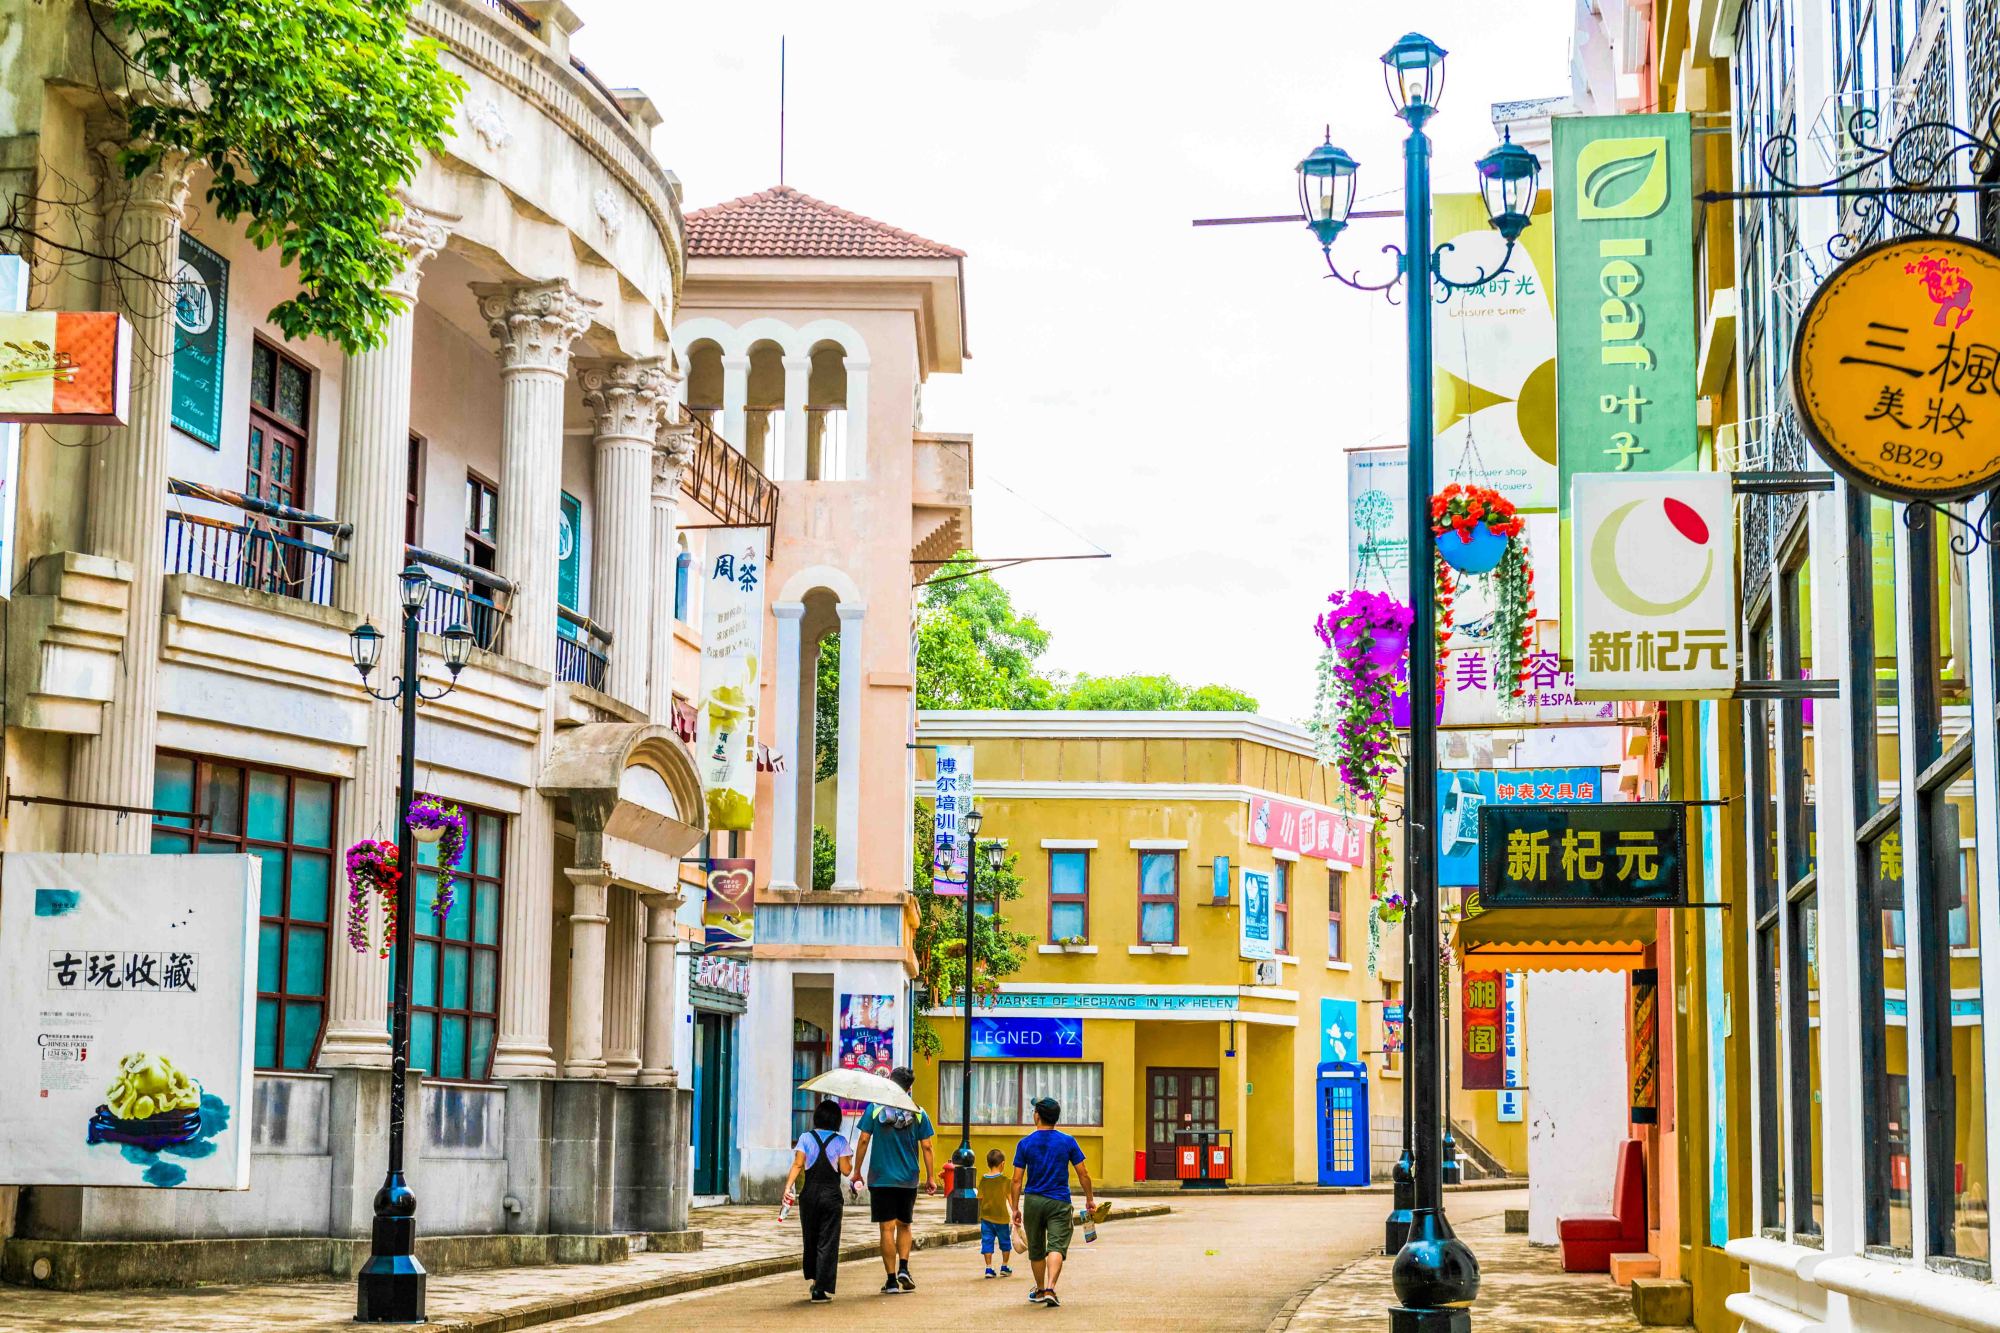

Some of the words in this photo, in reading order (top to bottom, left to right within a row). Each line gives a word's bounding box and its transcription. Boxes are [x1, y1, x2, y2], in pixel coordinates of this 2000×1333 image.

[1449, 307, 1494, 317] Leisure
[1497, 306, 1527, 315] time
[1600, 239, 1651, 370] leaf
[1840, 322, 2000, 396] 三楓
[1600, 384, 1651, 470] 叶子
[1506, 467, 1527, 479] shop
[1879, 441, 1943, 471] 8B29
[1494, 483, 1532, 491] flowers
[1456, 649, 1575, 692] 美容
[1588, 629, 1729, 673] 新杞元
[935, 757, 957, 864] 博尔培训中
[1498, 783, 1594, 800] 钟表文具店
[1507, 828, 1660, 882] 新杞元
[53, 952, 197, 992] 古玩收藏
[996, 996, 1046, 1006] MARKET
[1053, 997, 1068, 1006] OF
[1074, 997, 1136, 1007] HECHANG
[1147, 998, 1159, 1008] IN
[1192, 999, 1233, 1009] HELEN
[1468, 980, 1497, 1054] 湘阁
[37, 1033, 69, 1048] CHINESE
[975, 1031, 1042, 1045] LEGNED
[1055, 1031, 1076, 1045] YZ
